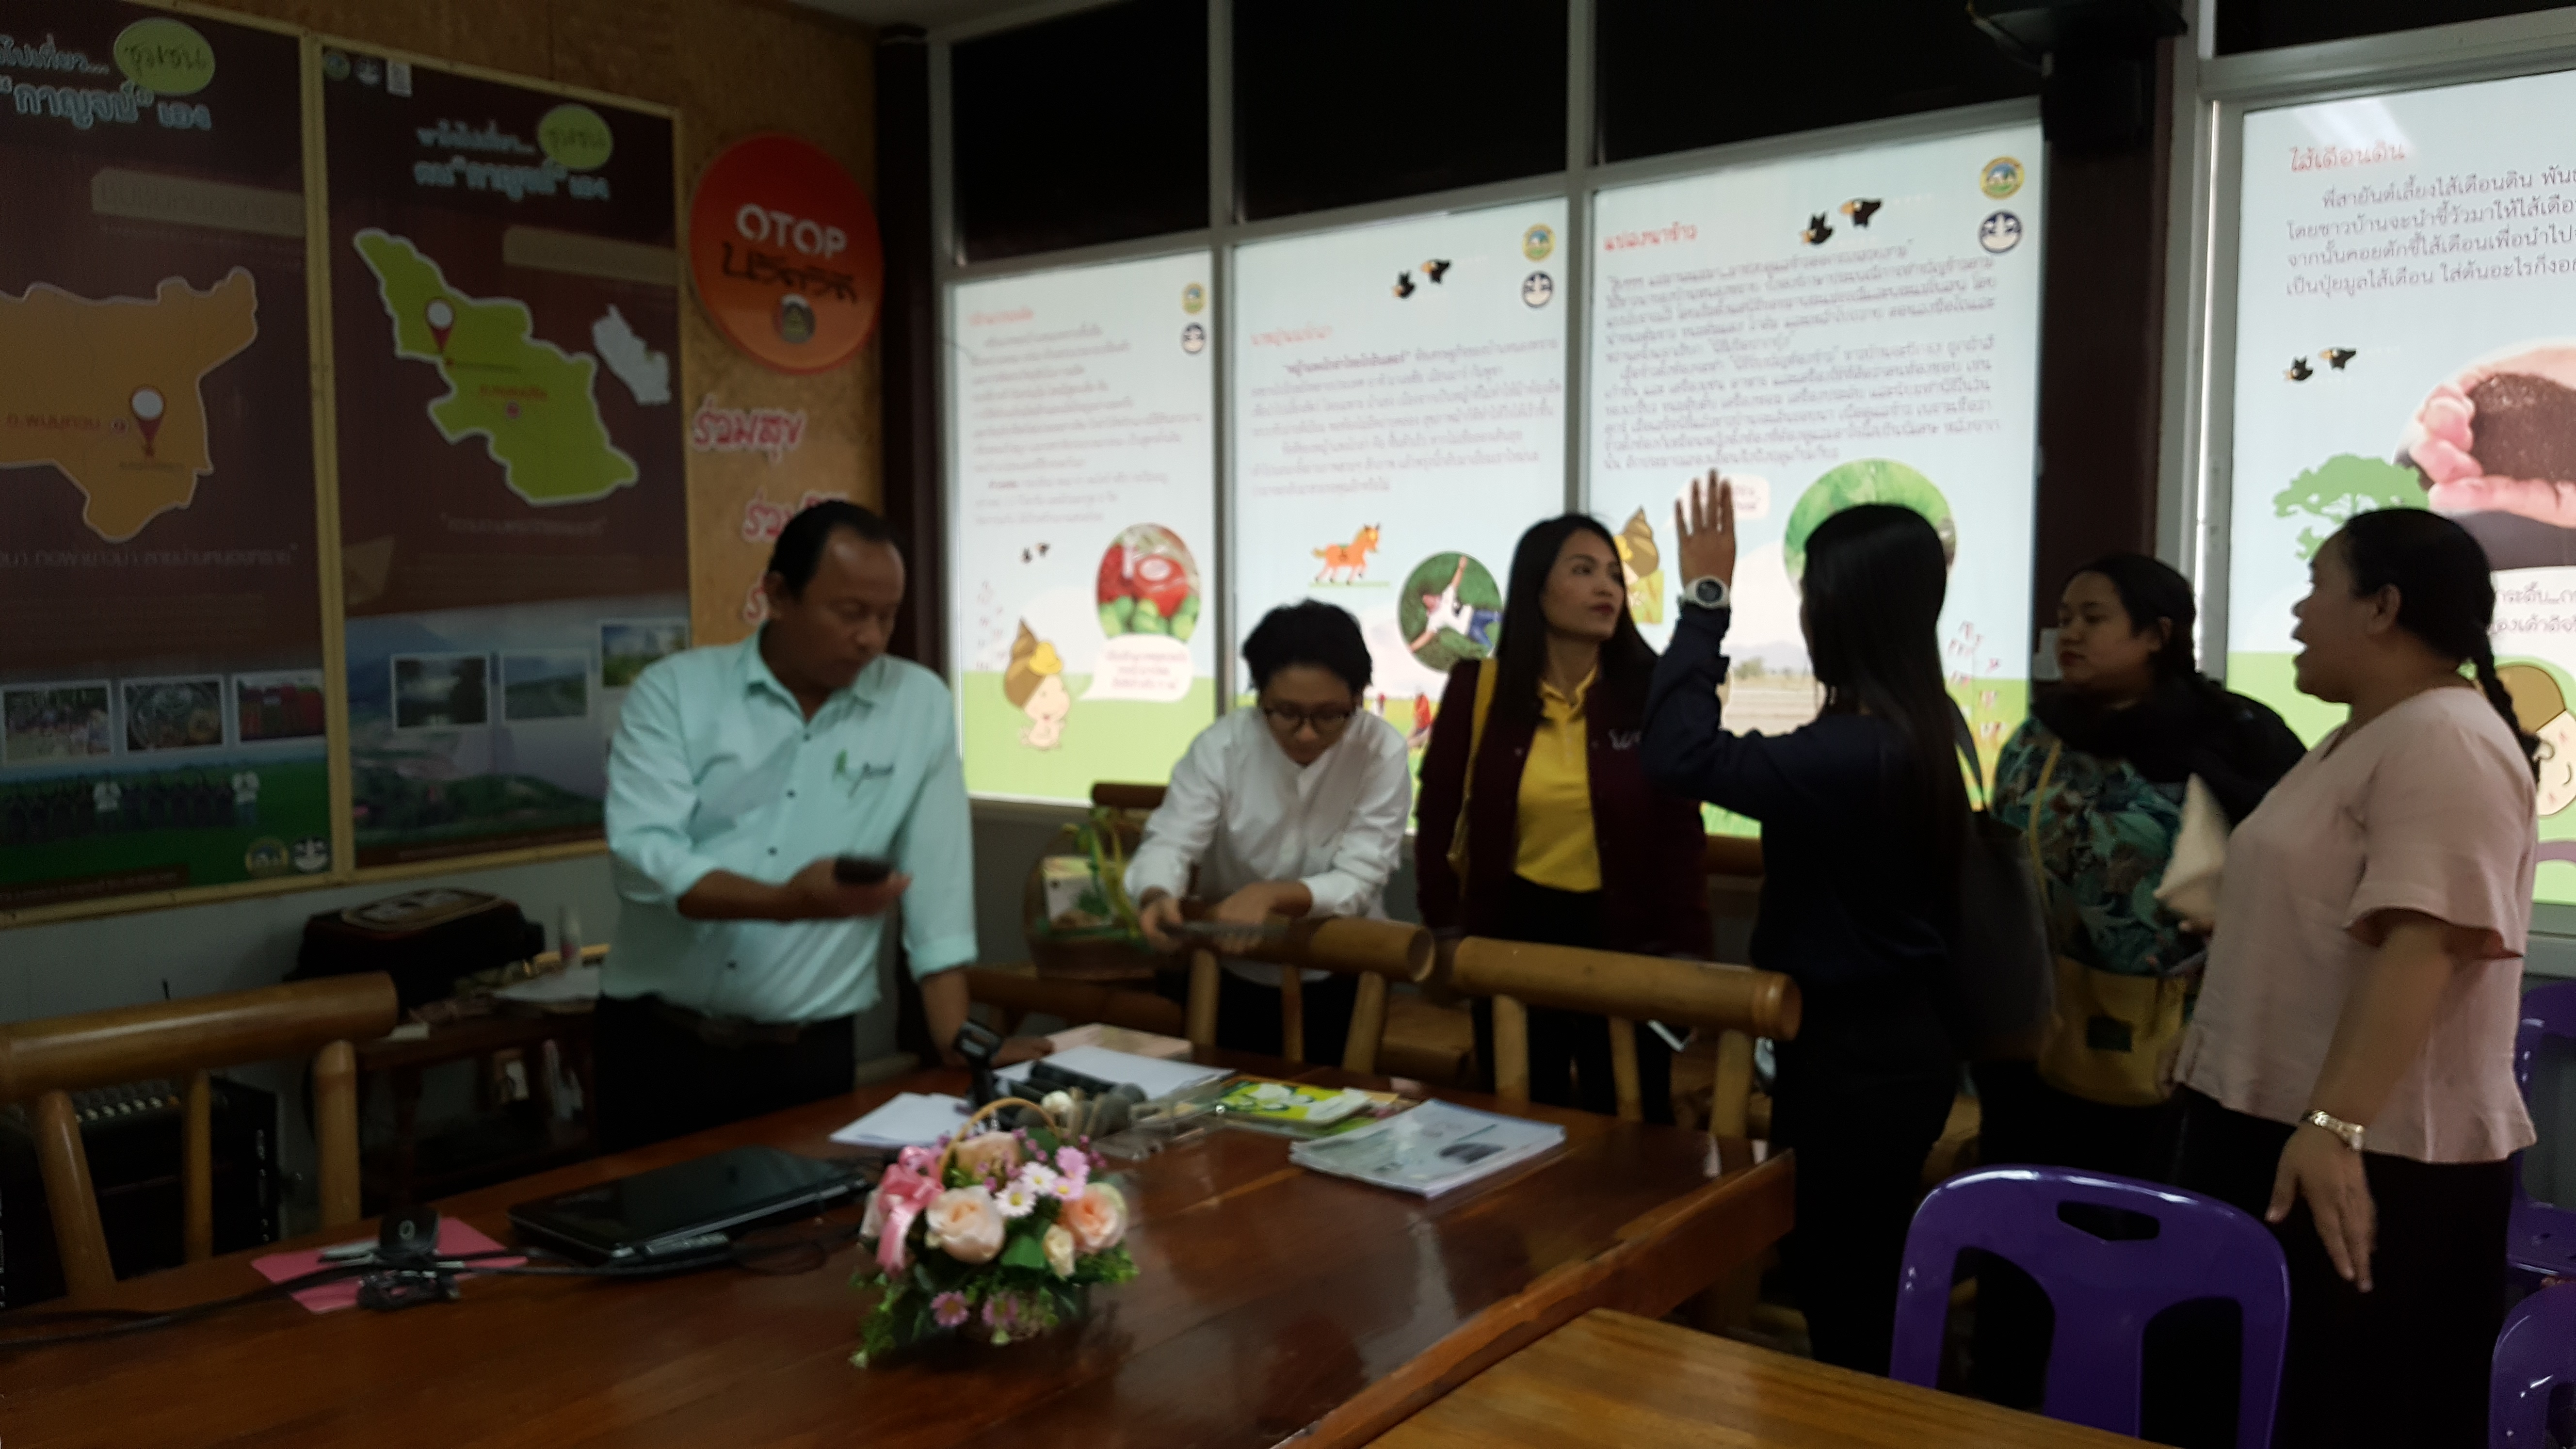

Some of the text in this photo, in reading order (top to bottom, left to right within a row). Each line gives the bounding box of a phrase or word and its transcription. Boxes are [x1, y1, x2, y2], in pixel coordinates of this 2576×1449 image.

[736, 203, 848, 259] OTOP
[2286, 193, 2576, 241] โดยชาวบ้านจะนำขี้วัวมาให้ไส้เดือ
